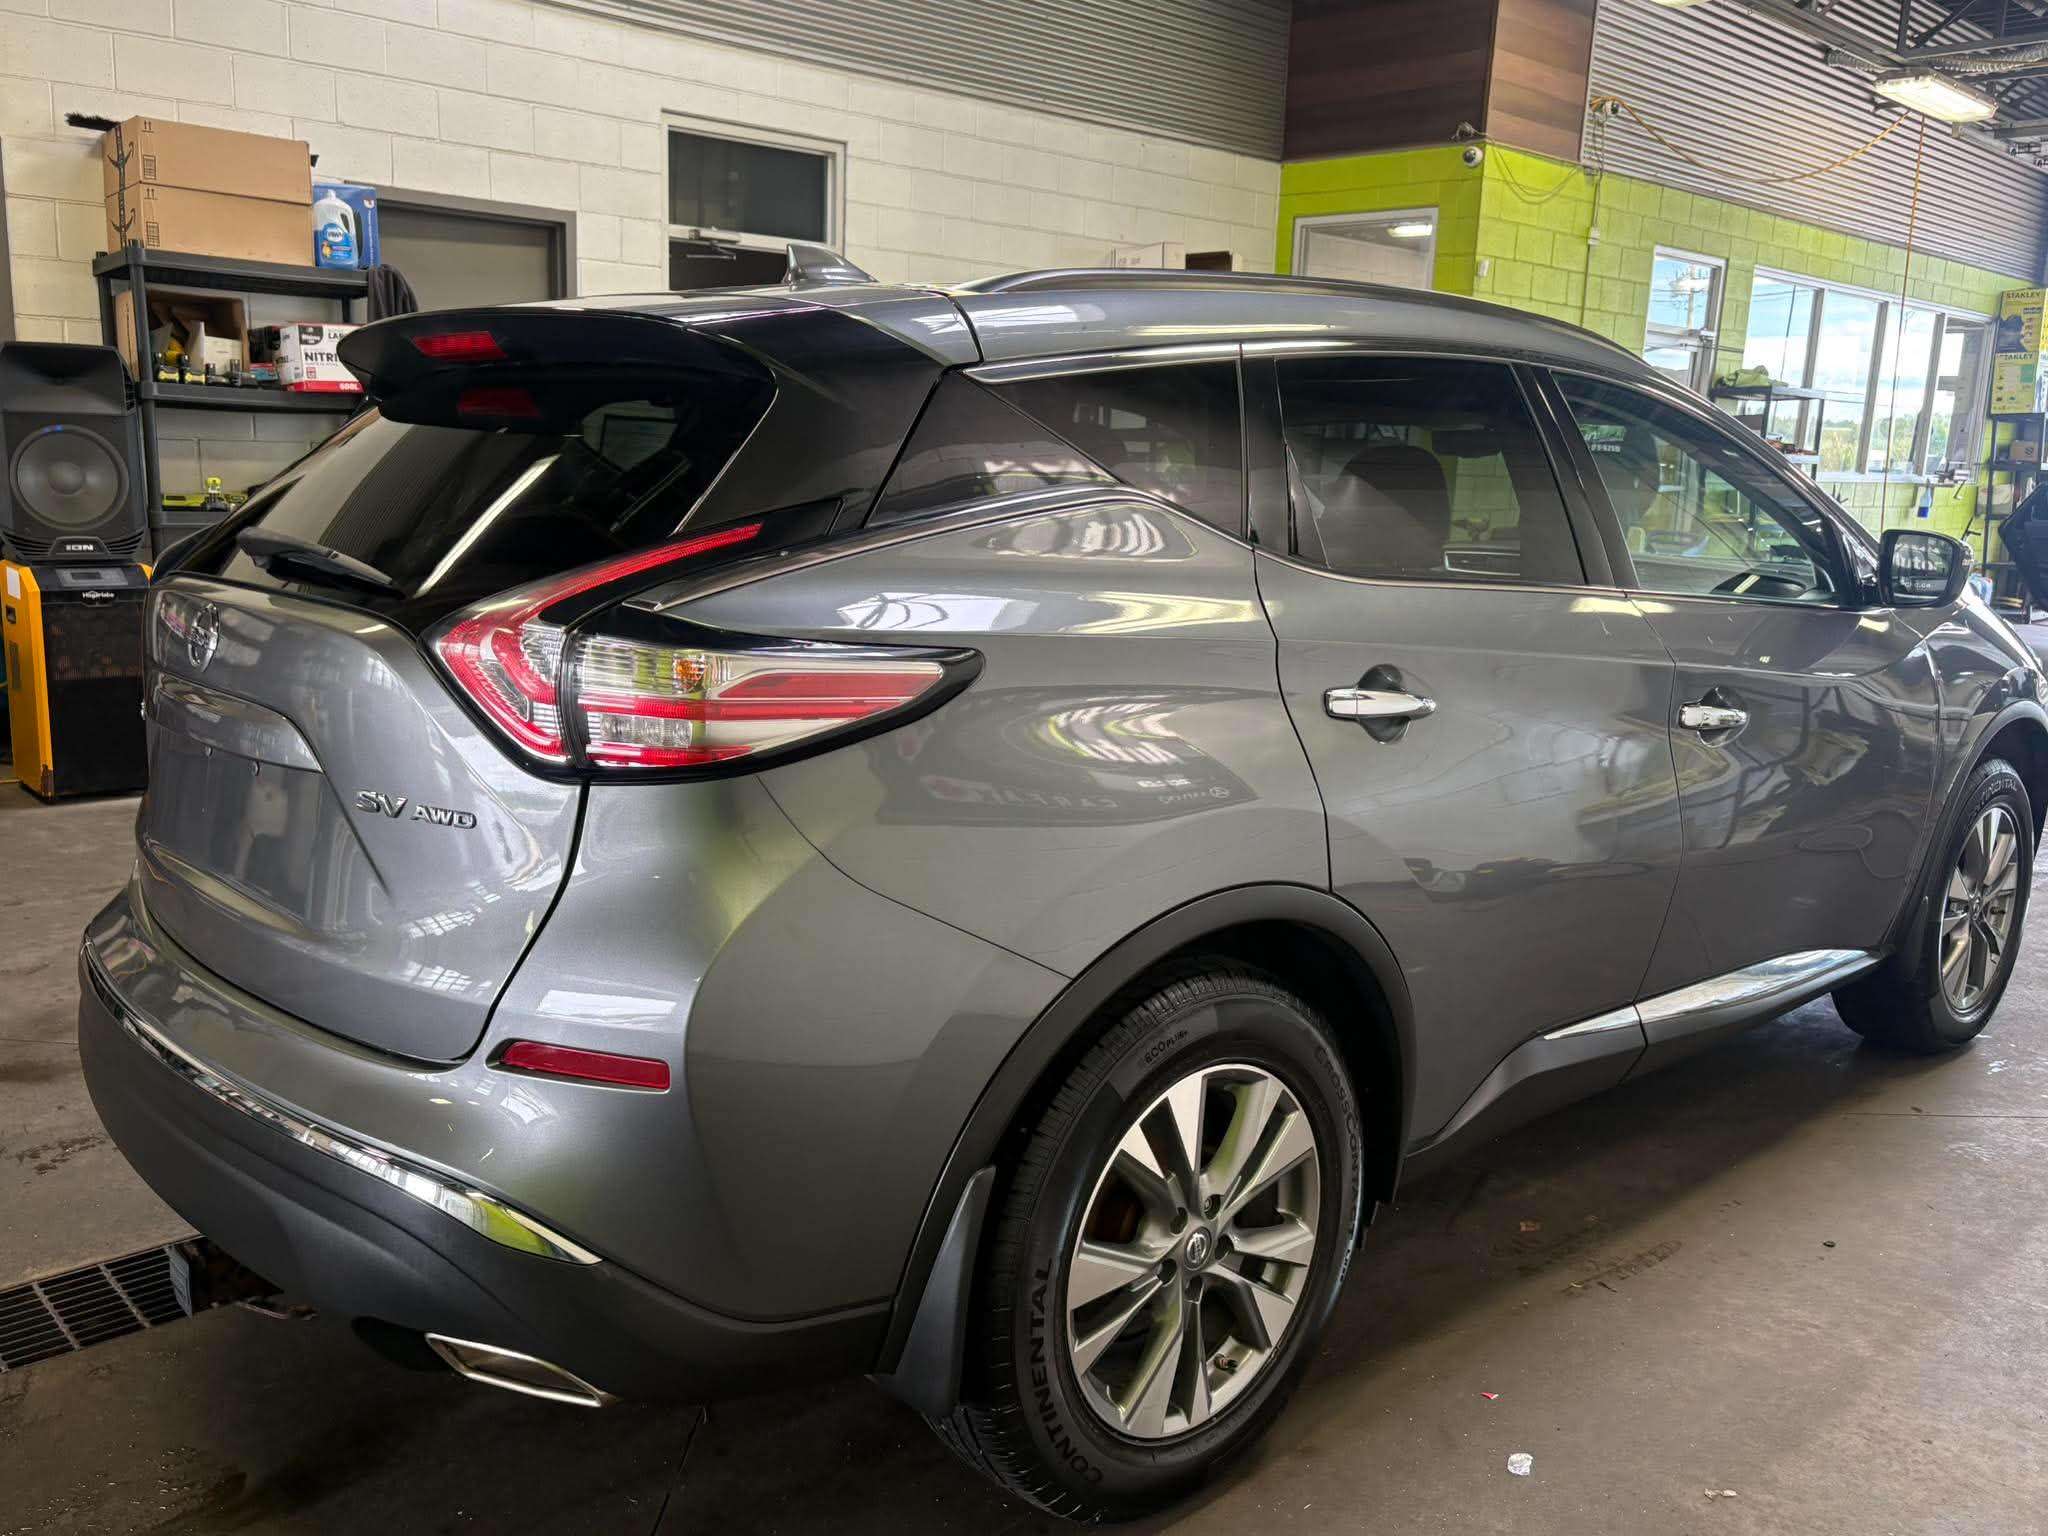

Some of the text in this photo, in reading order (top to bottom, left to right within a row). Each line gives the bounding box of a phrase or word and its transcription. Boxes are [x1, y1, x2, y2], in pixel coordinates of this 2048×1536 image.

[2006, 291, 2041, 299] STANLEY
[304, 352, 338, 362] NITRI
[2000, 353, 2033, 361] TANLEY
[356, 789, 478, 829] SV AWD
[1029, 1256, 1103, 1485] CONTINENTAL
